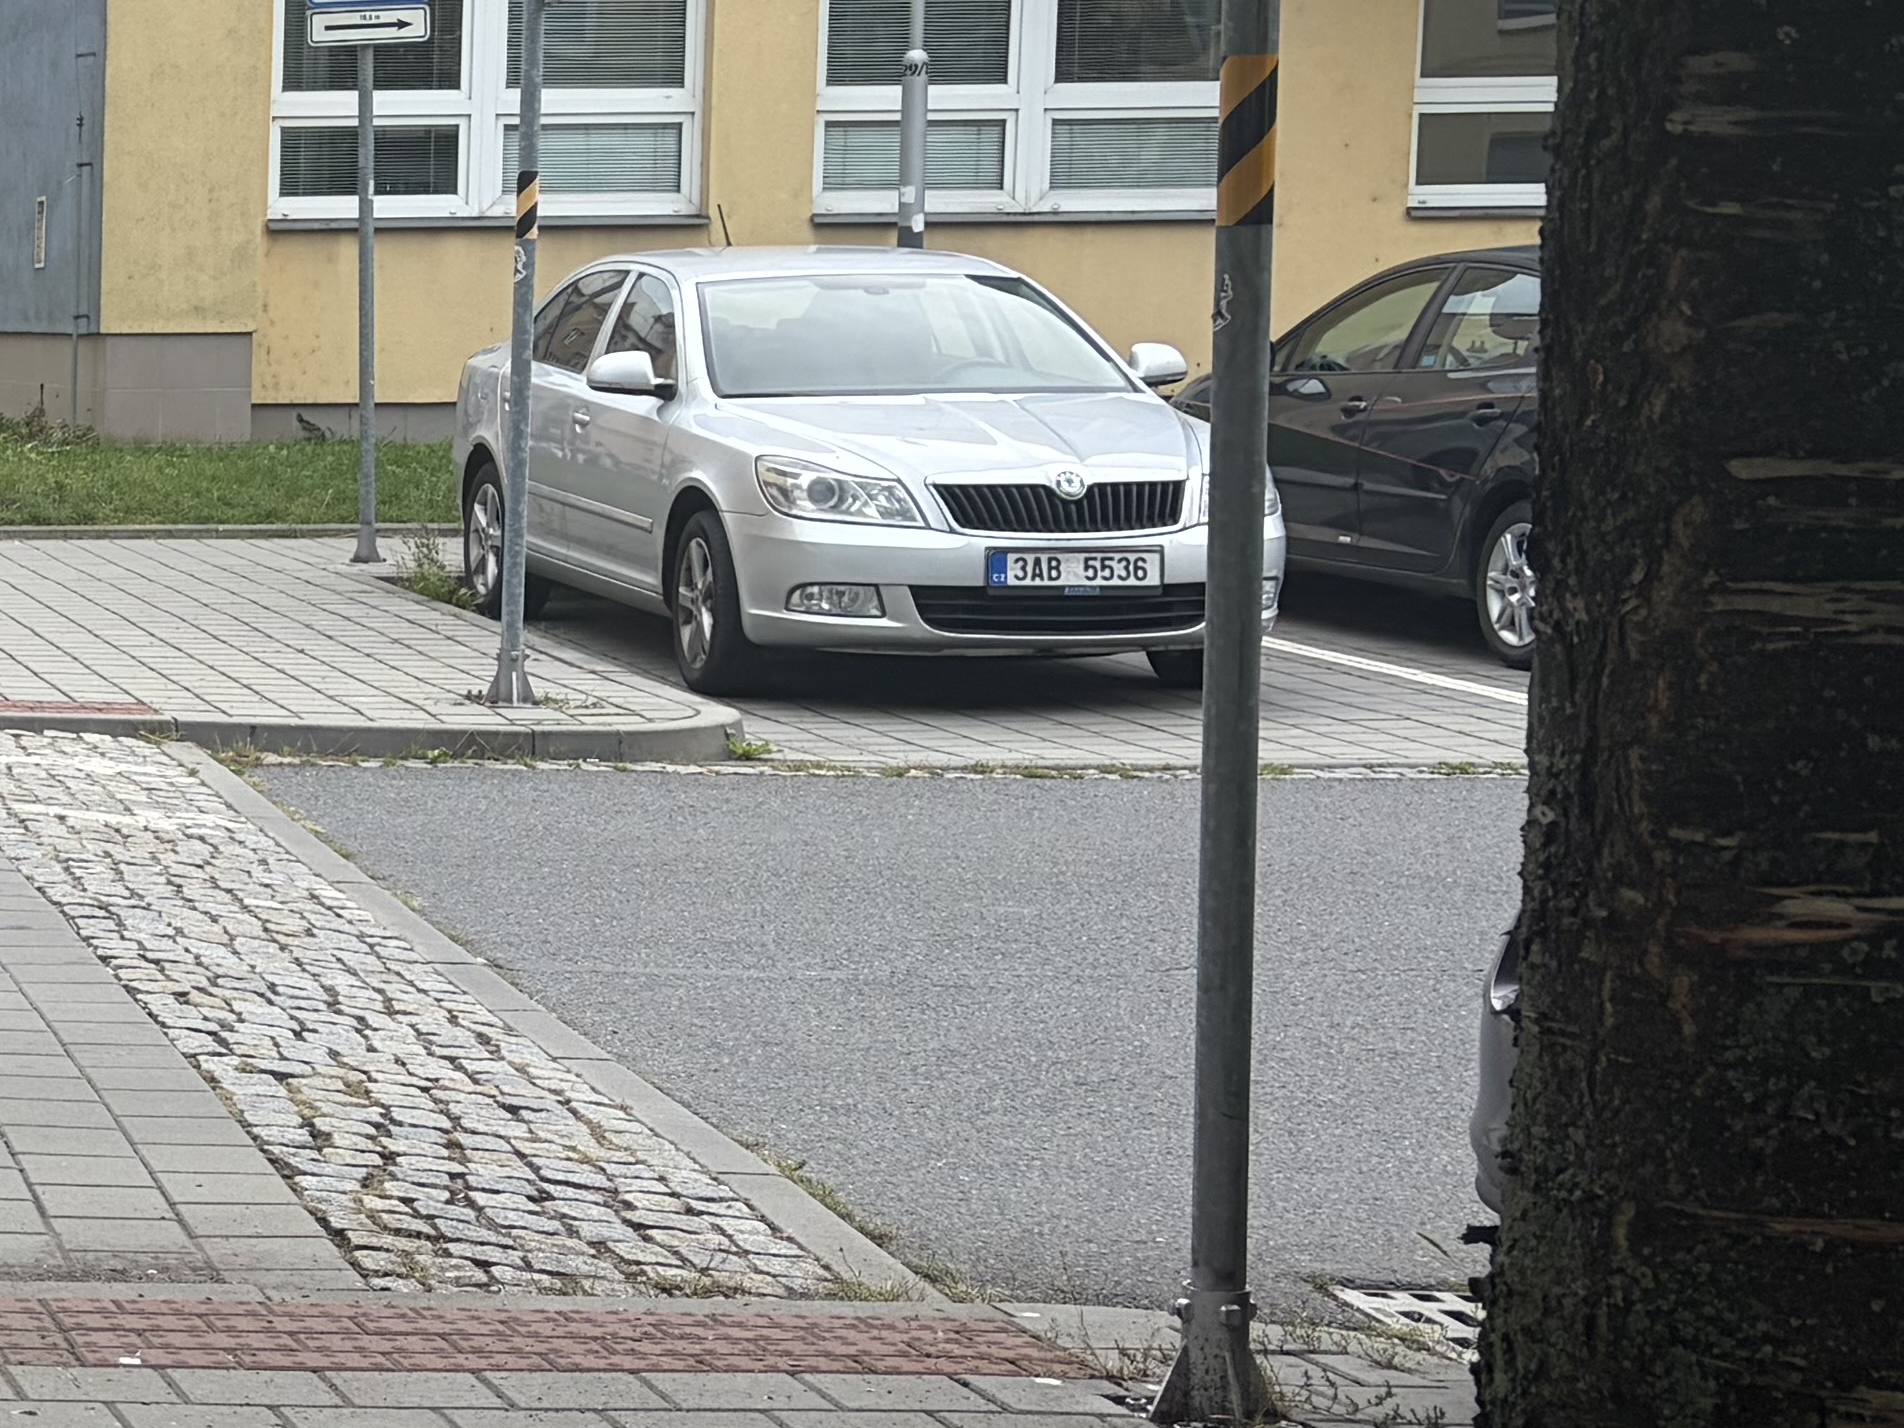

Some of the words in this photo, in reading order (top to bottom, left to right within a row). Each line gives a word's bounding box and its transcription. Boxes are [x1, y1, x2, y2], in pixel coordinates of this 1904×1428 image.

[992, 573, 1006, 582] CZ
[1013, 556, 1062, 582] 3AB
[1083, 556, 1149, 582] 5536
